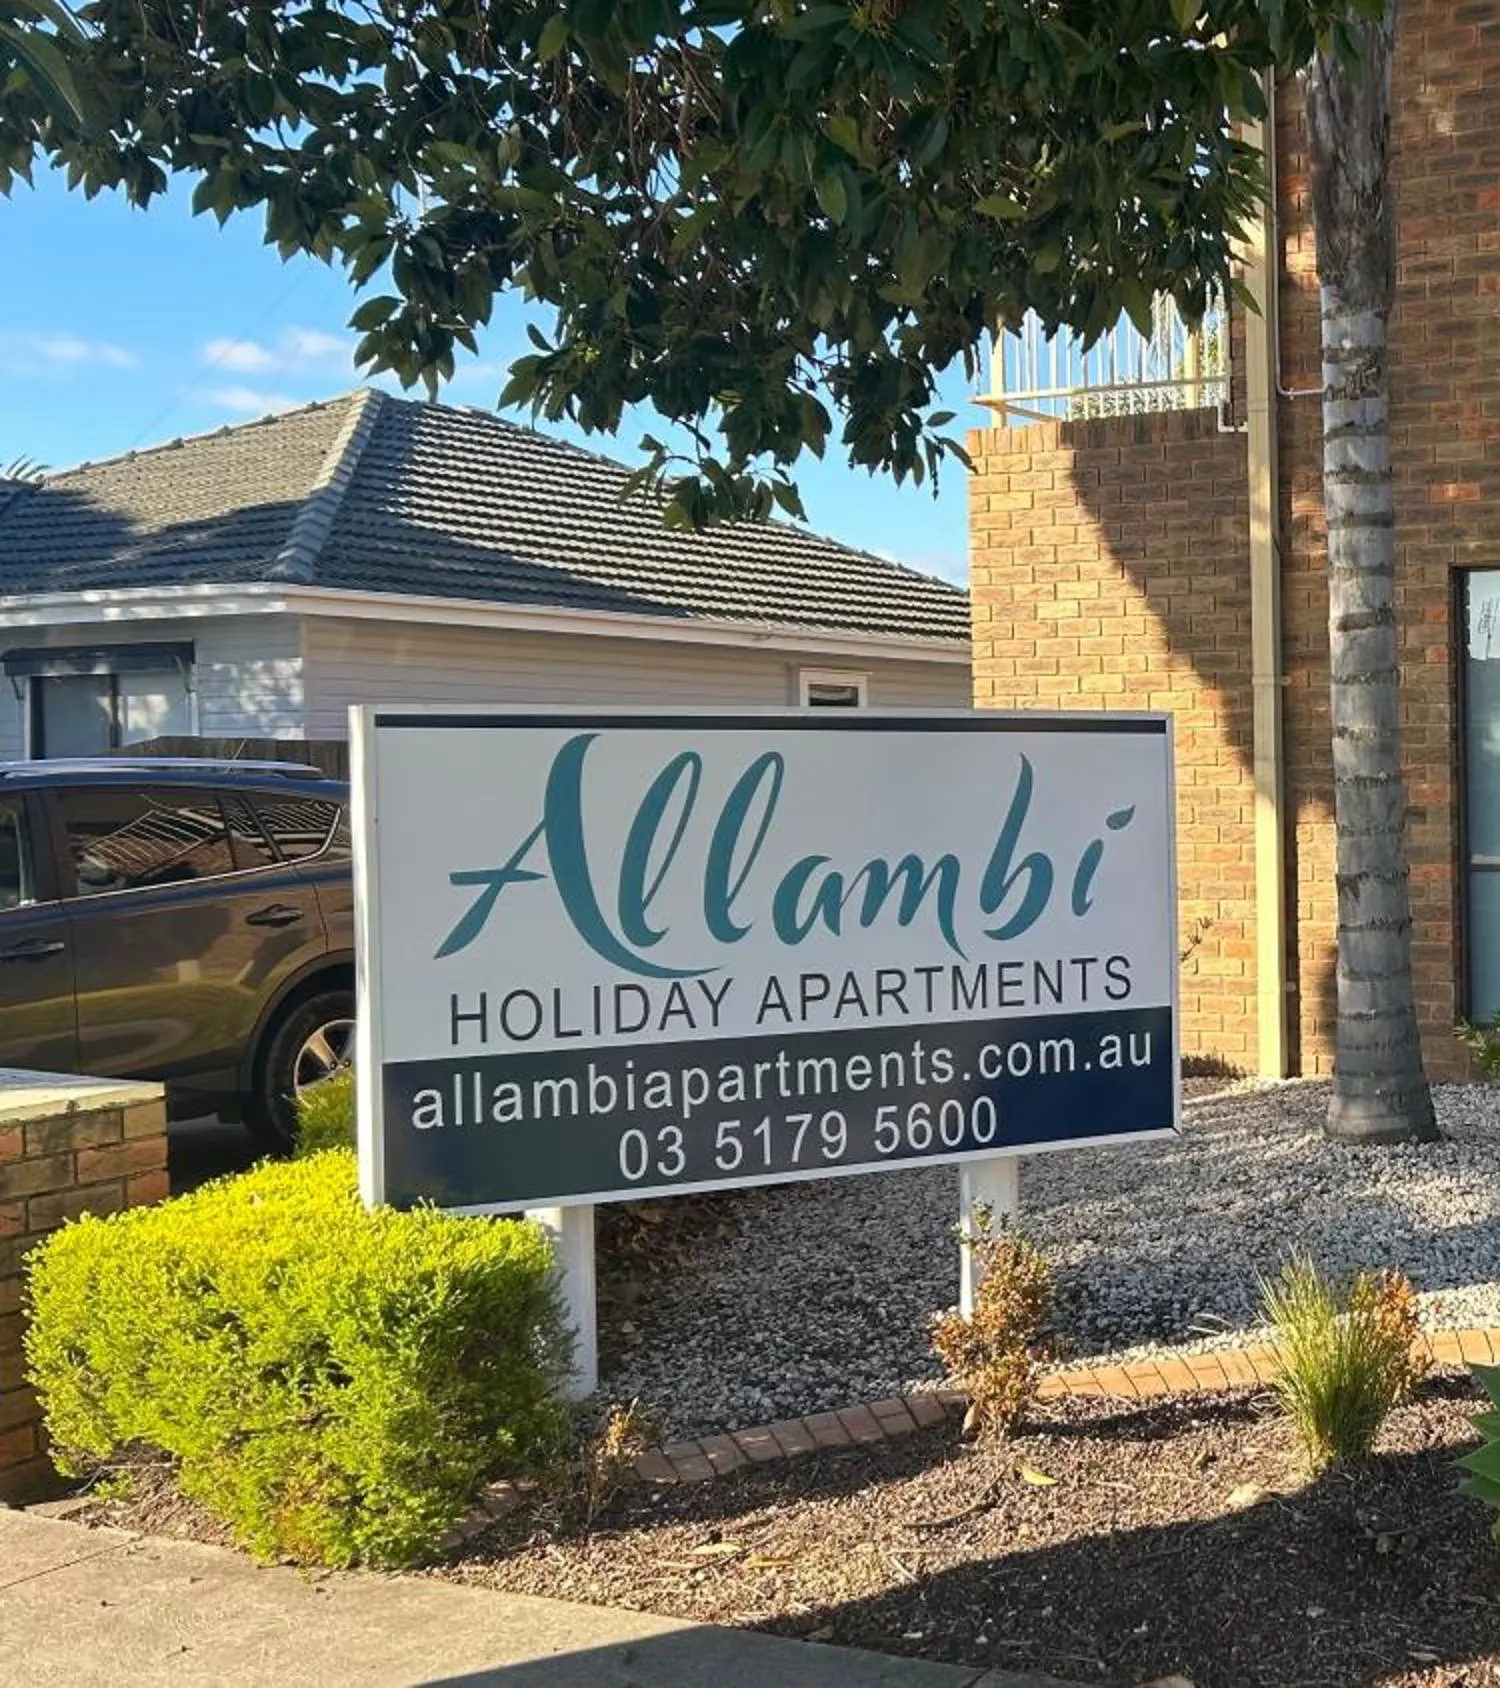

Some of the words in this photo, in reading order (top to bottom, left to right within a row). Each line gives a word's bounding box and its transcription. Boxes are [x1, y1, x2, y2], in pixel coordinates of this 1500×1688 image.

[432, 733, 1136, 979] Allambi
[448, 977, 735, 1046] HOLIDAY
[755, 955, 1134, 1025] APARTMENTS
[411, 1029, 1154, 1131] allambiapartments.com.au
[618, 1126, 686, 1182] 03
[714, 1110, 848, 1171] 5179
[874, 1095, 998, 1156] 5600
